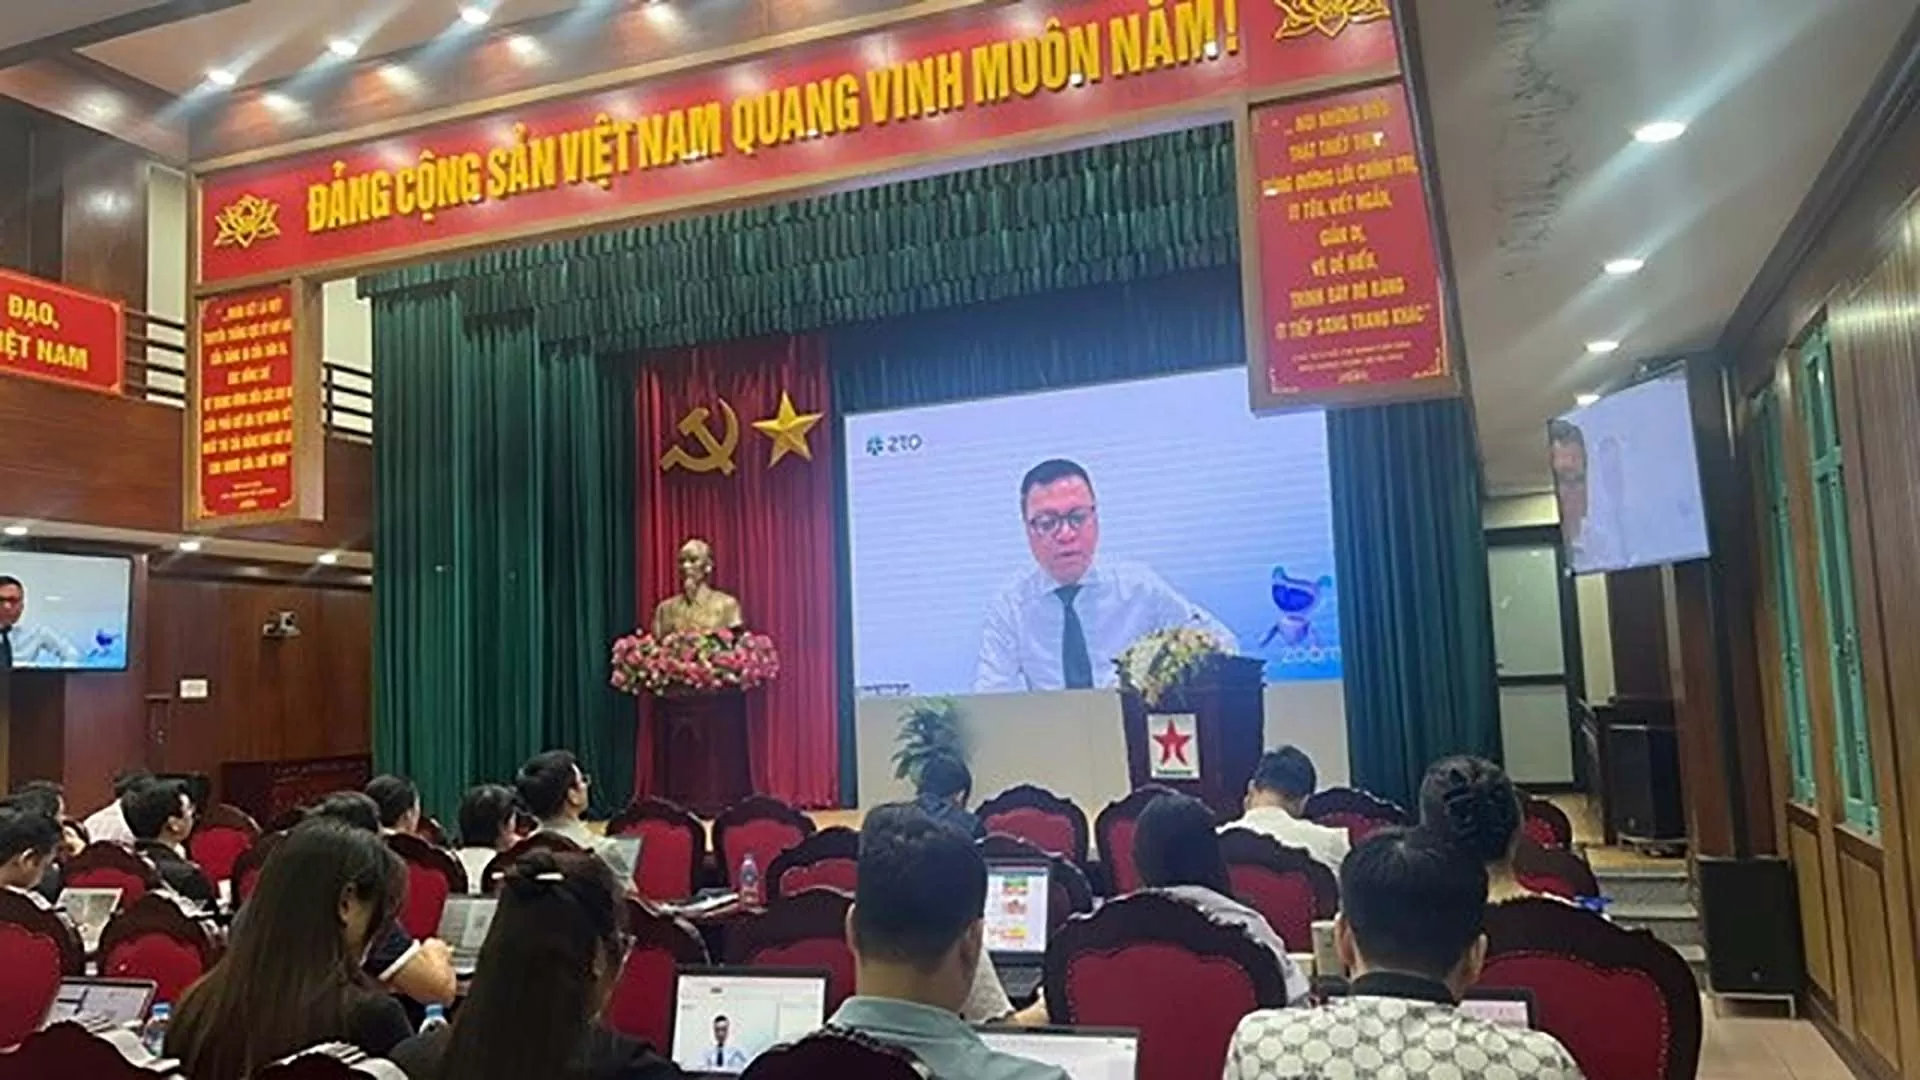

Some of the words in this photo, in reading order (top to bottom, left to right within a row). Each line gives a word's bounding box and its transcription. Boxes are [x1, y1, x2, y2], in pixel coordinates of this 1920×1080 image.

[308, 160, 391, 233] ĐẢNG
[395, 149, 482, 222] CỘNG
[487, 121, 557, 198] SẢN
[560, 111, 633, 188] VIỆT
[636, 100, 722, 169] NAM
[731, 73, 861, 154] QUANG
[866, 50, 964, 124] VINH
[971, 16, 1100, 104] MUÔN
[36, 338, 88, 372] NAM
